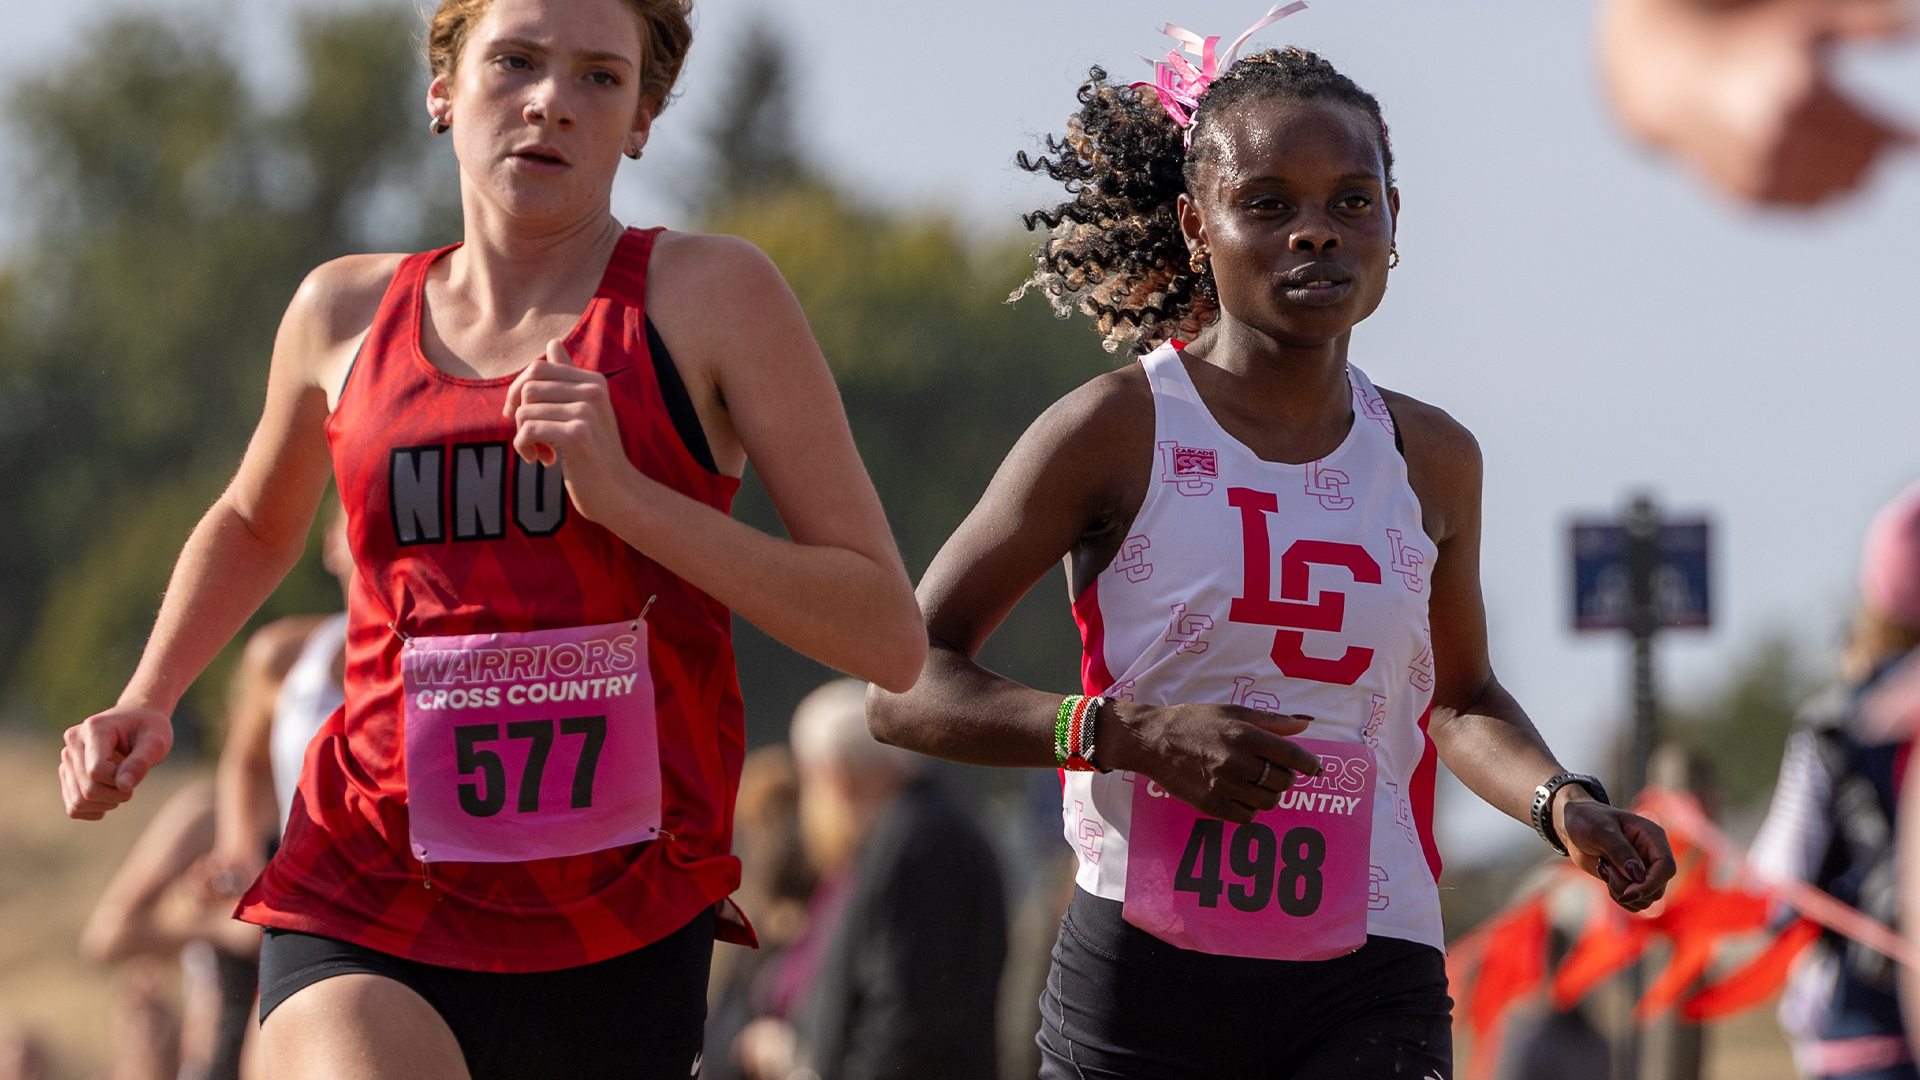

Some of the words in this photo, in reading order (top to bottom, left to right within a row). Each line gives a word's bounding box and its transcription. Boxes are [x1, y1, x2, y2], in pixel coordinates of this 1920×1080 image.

[1175, 448, 1214, 456] CASCADE
[1177, 455, 1214, 470] CCC
[389, 441, 569, 547] NNU
[1305, 460, 1354, 511] LC
[1227, 487, 1382, 686] LC
[1386, 528, 1423, 593] LC
[1165, 602, 1214, 655] LC
[412, 635, 637, 685] WARRIORS
[416, 689, 500, 711] CROSS
[507, 673, 638, 705] COUNTRY
[454, 715, 608, 818] 577
[1278, 791, 1362, 816] UNTRY
[1174, 817, 1326, 918] 498
